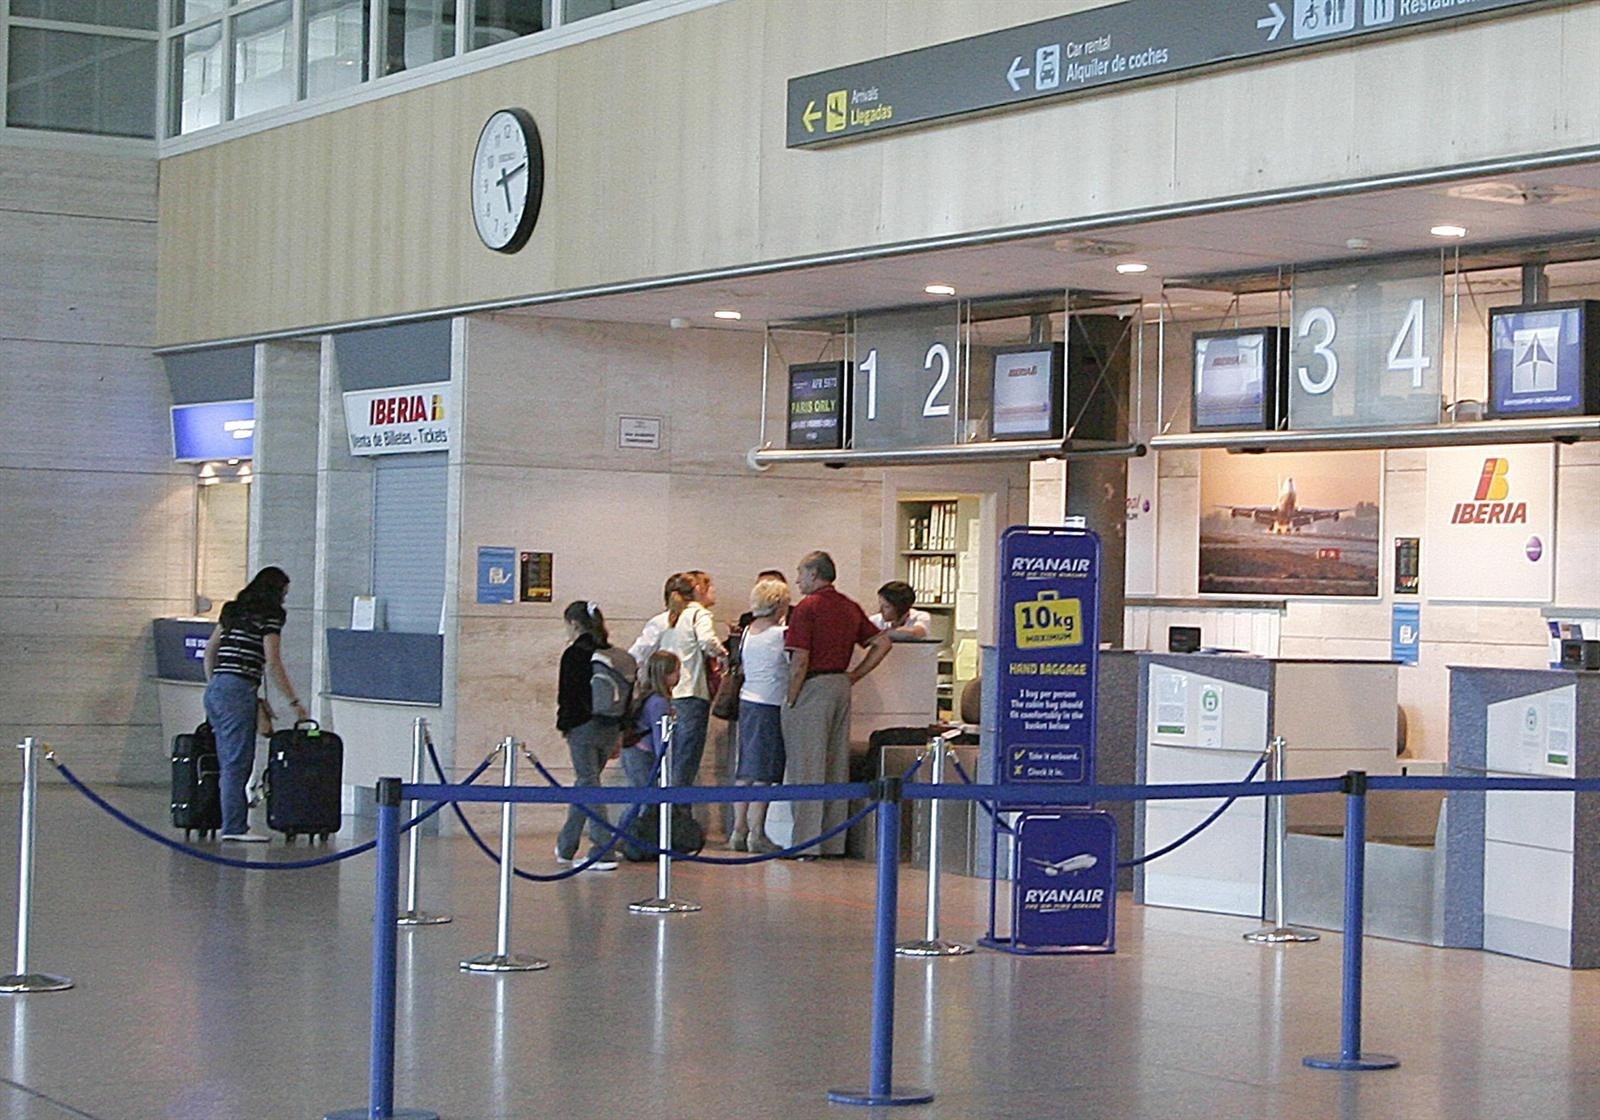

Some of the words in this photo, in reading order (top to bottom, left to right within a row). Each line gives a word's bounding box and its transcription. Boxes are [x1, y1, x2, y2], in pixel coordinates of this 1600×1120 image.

[1066, 42, 1083, 58] Car
[1084, 34, 1111, 54] rental
[1066, 58, 1108, 82] Alquiler
[1111, 53, 1126, 72] de
[1129, 47, 1168, 69] coches
[851, 103, 893, 126] Llegadas
[1297, 306, 1338, 395] 3
[1387, 299, 1431, 388] 4
[859, 350, 877, 420] 1
[923, 343, 950, 417] 2
[369, 395, 428, 426] IBERIA
[1451, 502, 1527, 524] IBERIA
[1012, 557, 1090, 572] RYANAIR
[1021, 606, 1074, 631] 10kg
[1009, 663, 1037, 675] HAND
[1040, 663, 1087, 676] BAGGAGE
[1011, 699, 1024, 708] The
[1046, 701, 1058, 711] bag
[1060, 700, 1083, 709] should
[1026, 690, 1038, 701] bag
[1040, 691, 1052, 700] per
[1053, 691, 1077, 700] person
[1020, 711, 1061, 721] comfortably
[1063, 711, 1070, 719] in
[1072, 710, 1084, 719] the
[1025, 889, 1104, 903] RYANAIR
